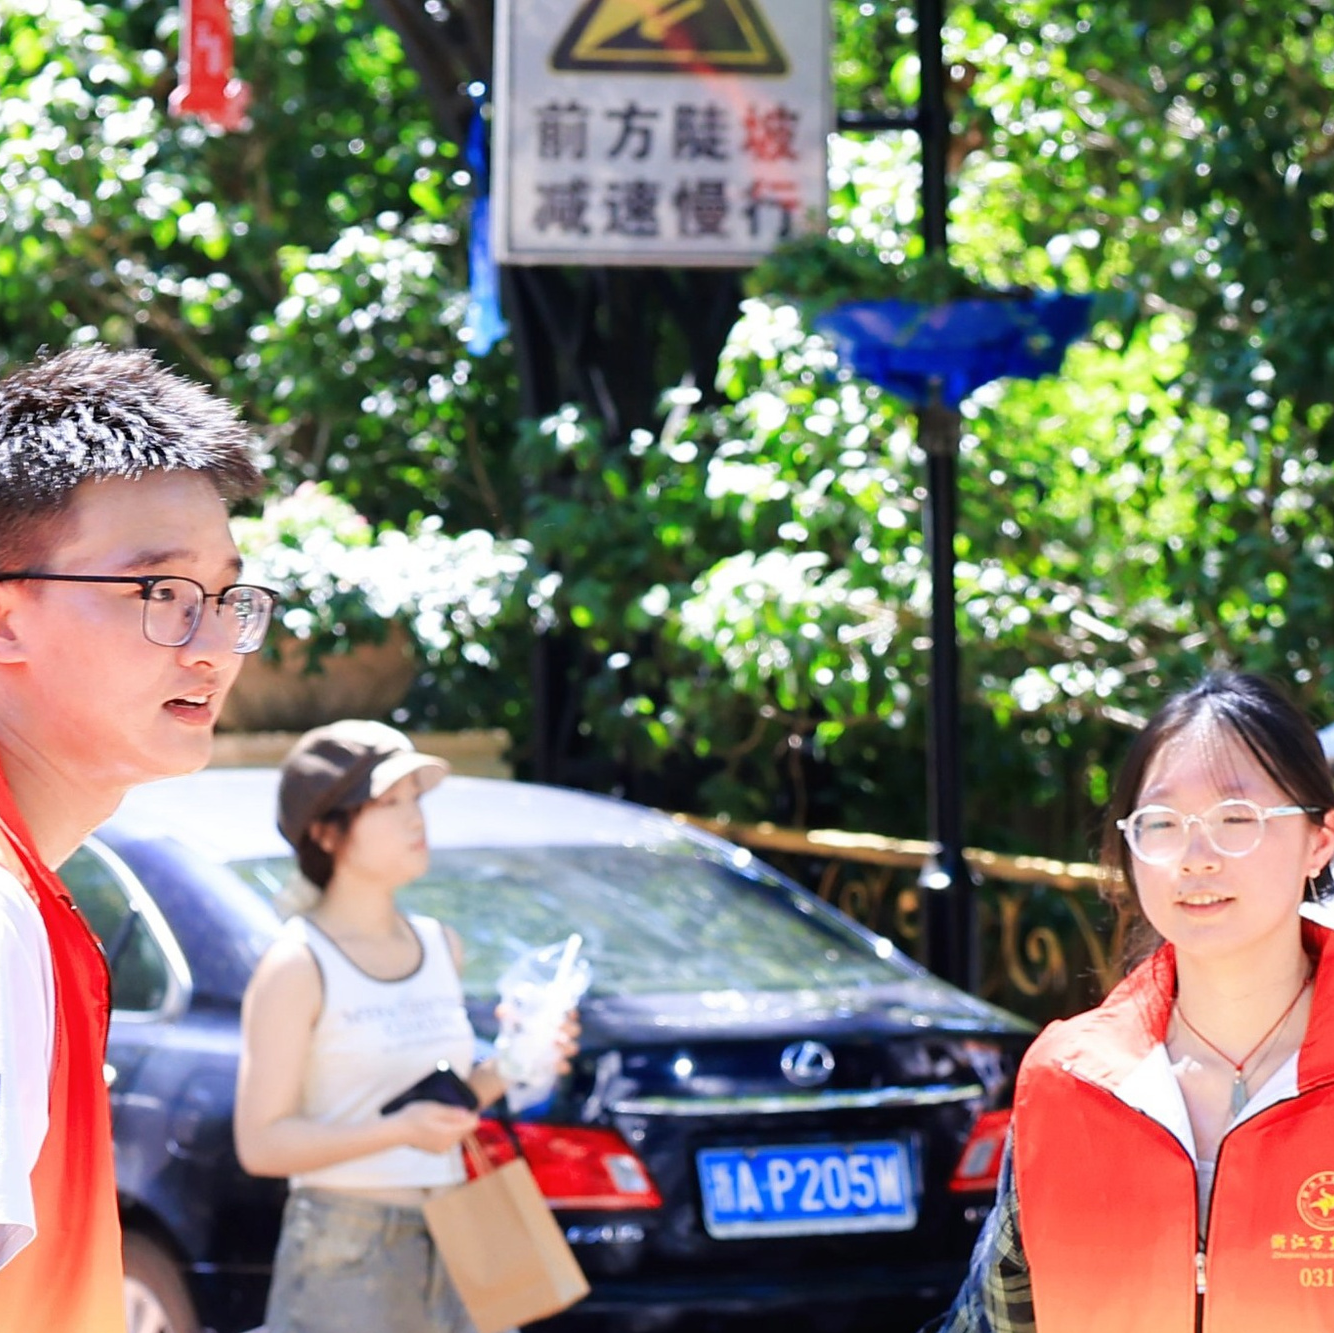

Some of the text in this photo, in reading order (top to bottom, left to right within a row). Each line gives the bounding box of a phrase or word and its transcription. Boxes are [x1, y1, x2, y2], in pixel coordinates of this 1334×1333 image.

[533, 99, 801, 162] 前方陡坡
[533, 178, 802, 239] 减速慢行
